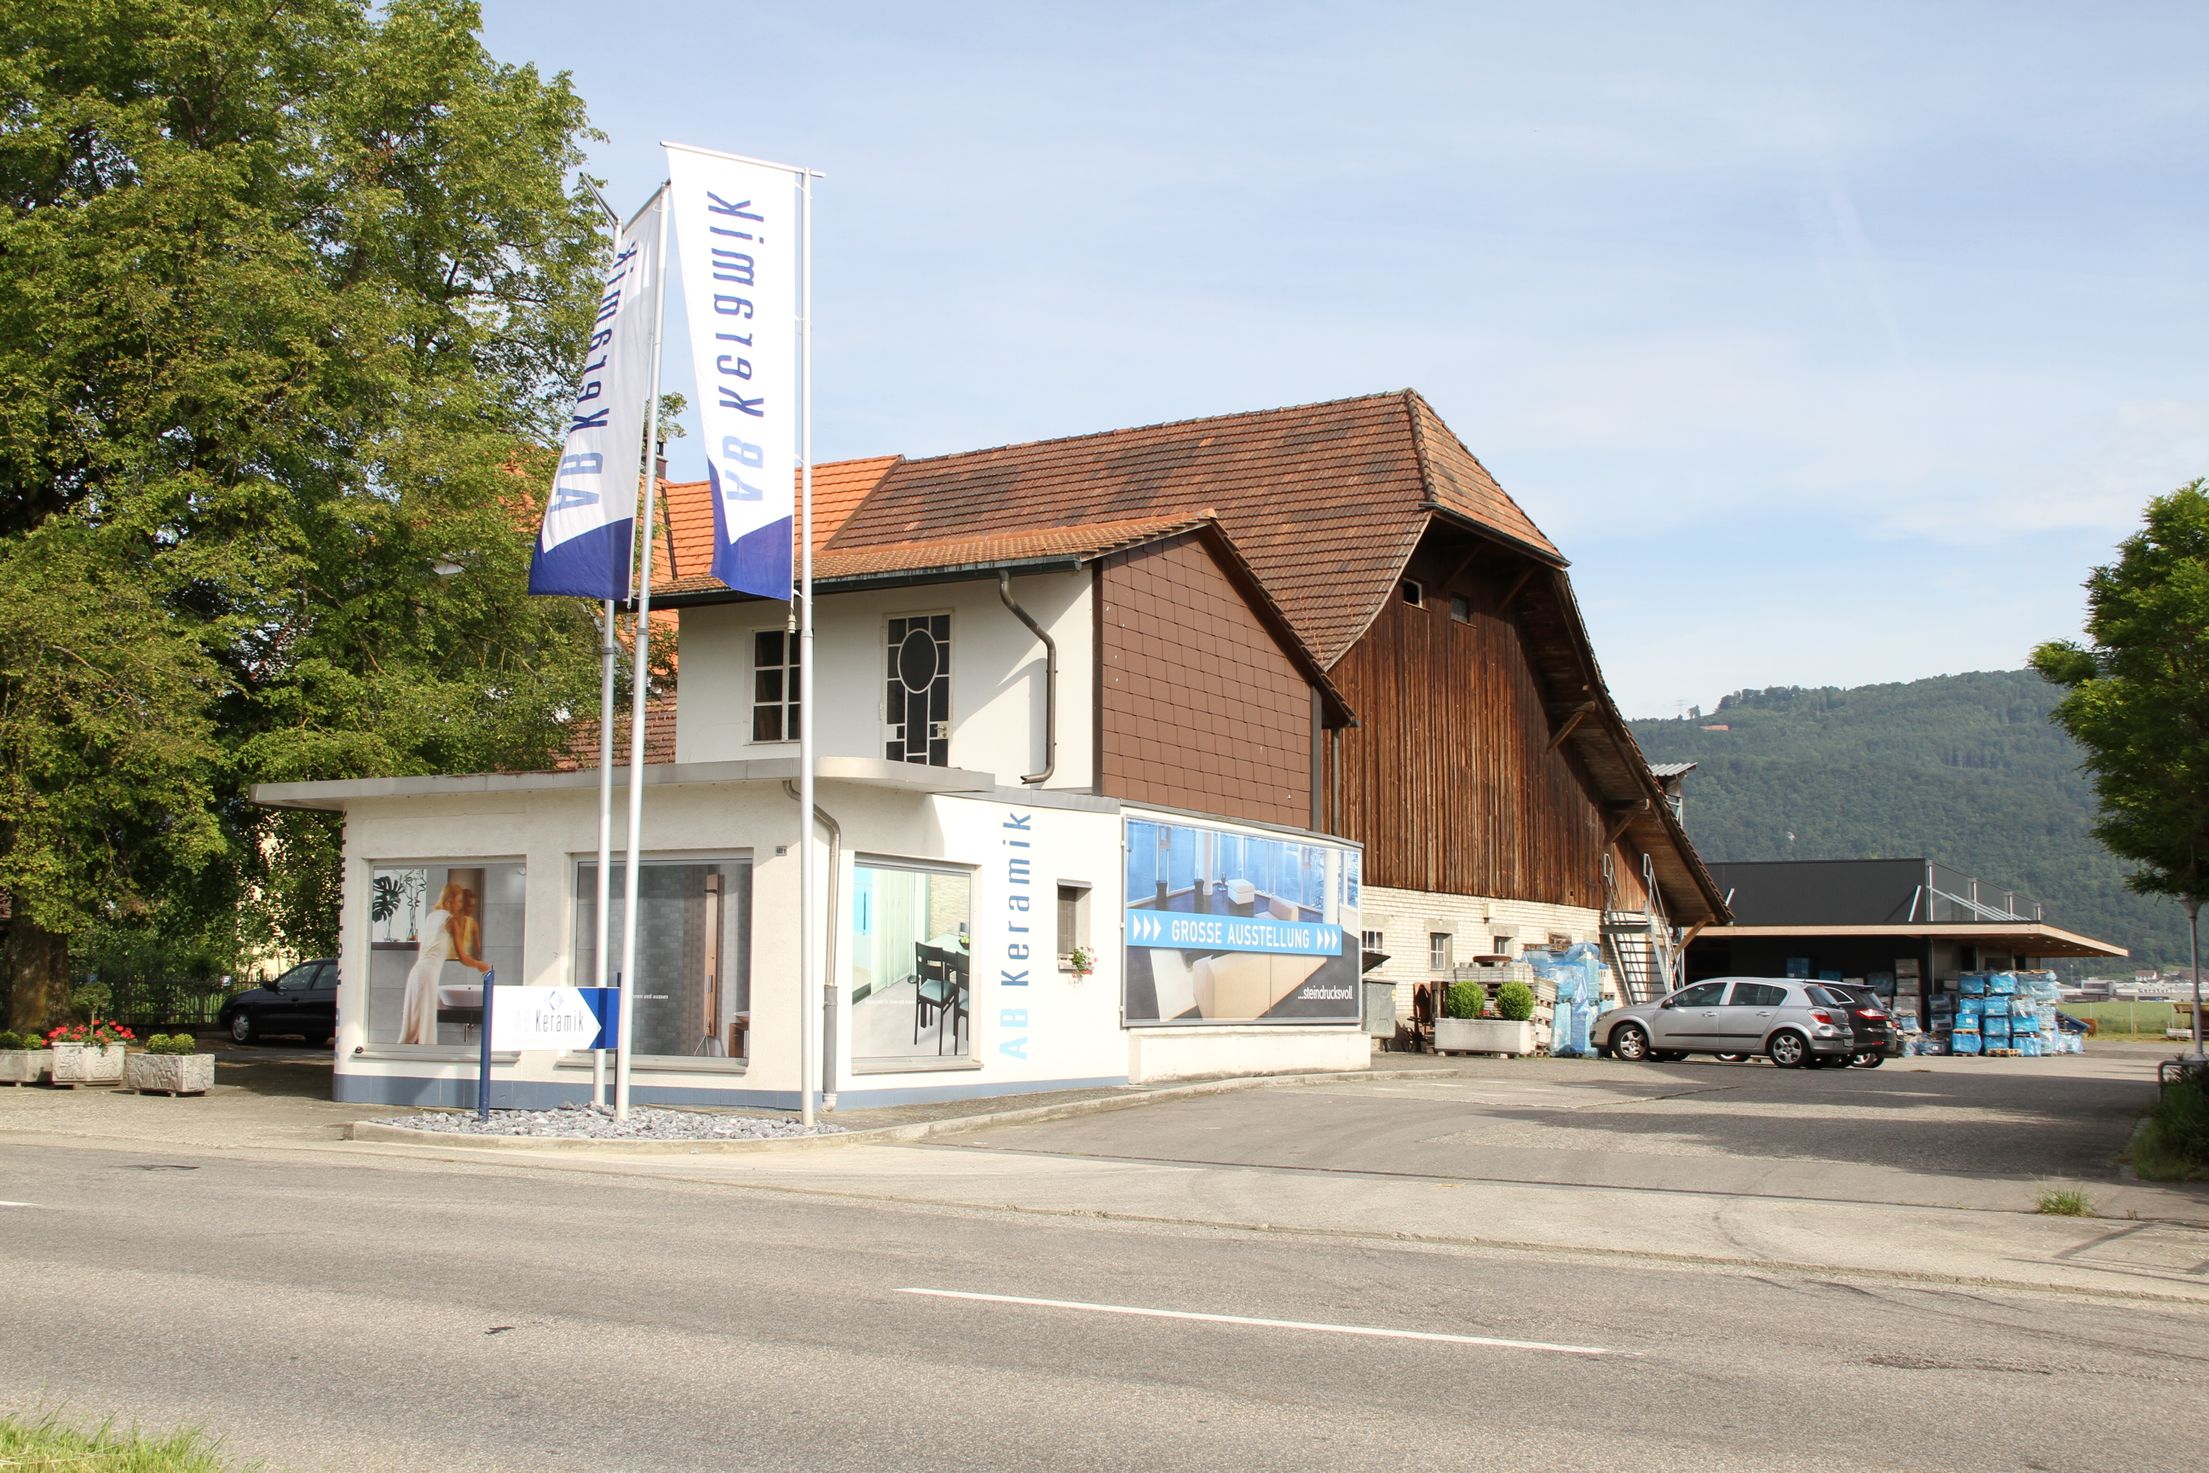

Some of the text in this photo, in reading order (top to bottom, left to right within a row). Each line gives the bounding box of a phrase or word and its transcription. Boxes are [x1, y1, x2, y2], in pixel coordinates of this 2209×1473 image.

[999, 812, 1032, 1061] AB Keramik
[1171, 919, 1310, 950] GROSSE AUSSTELLUNG
[535, 1009, 585, 1033] Keramik
